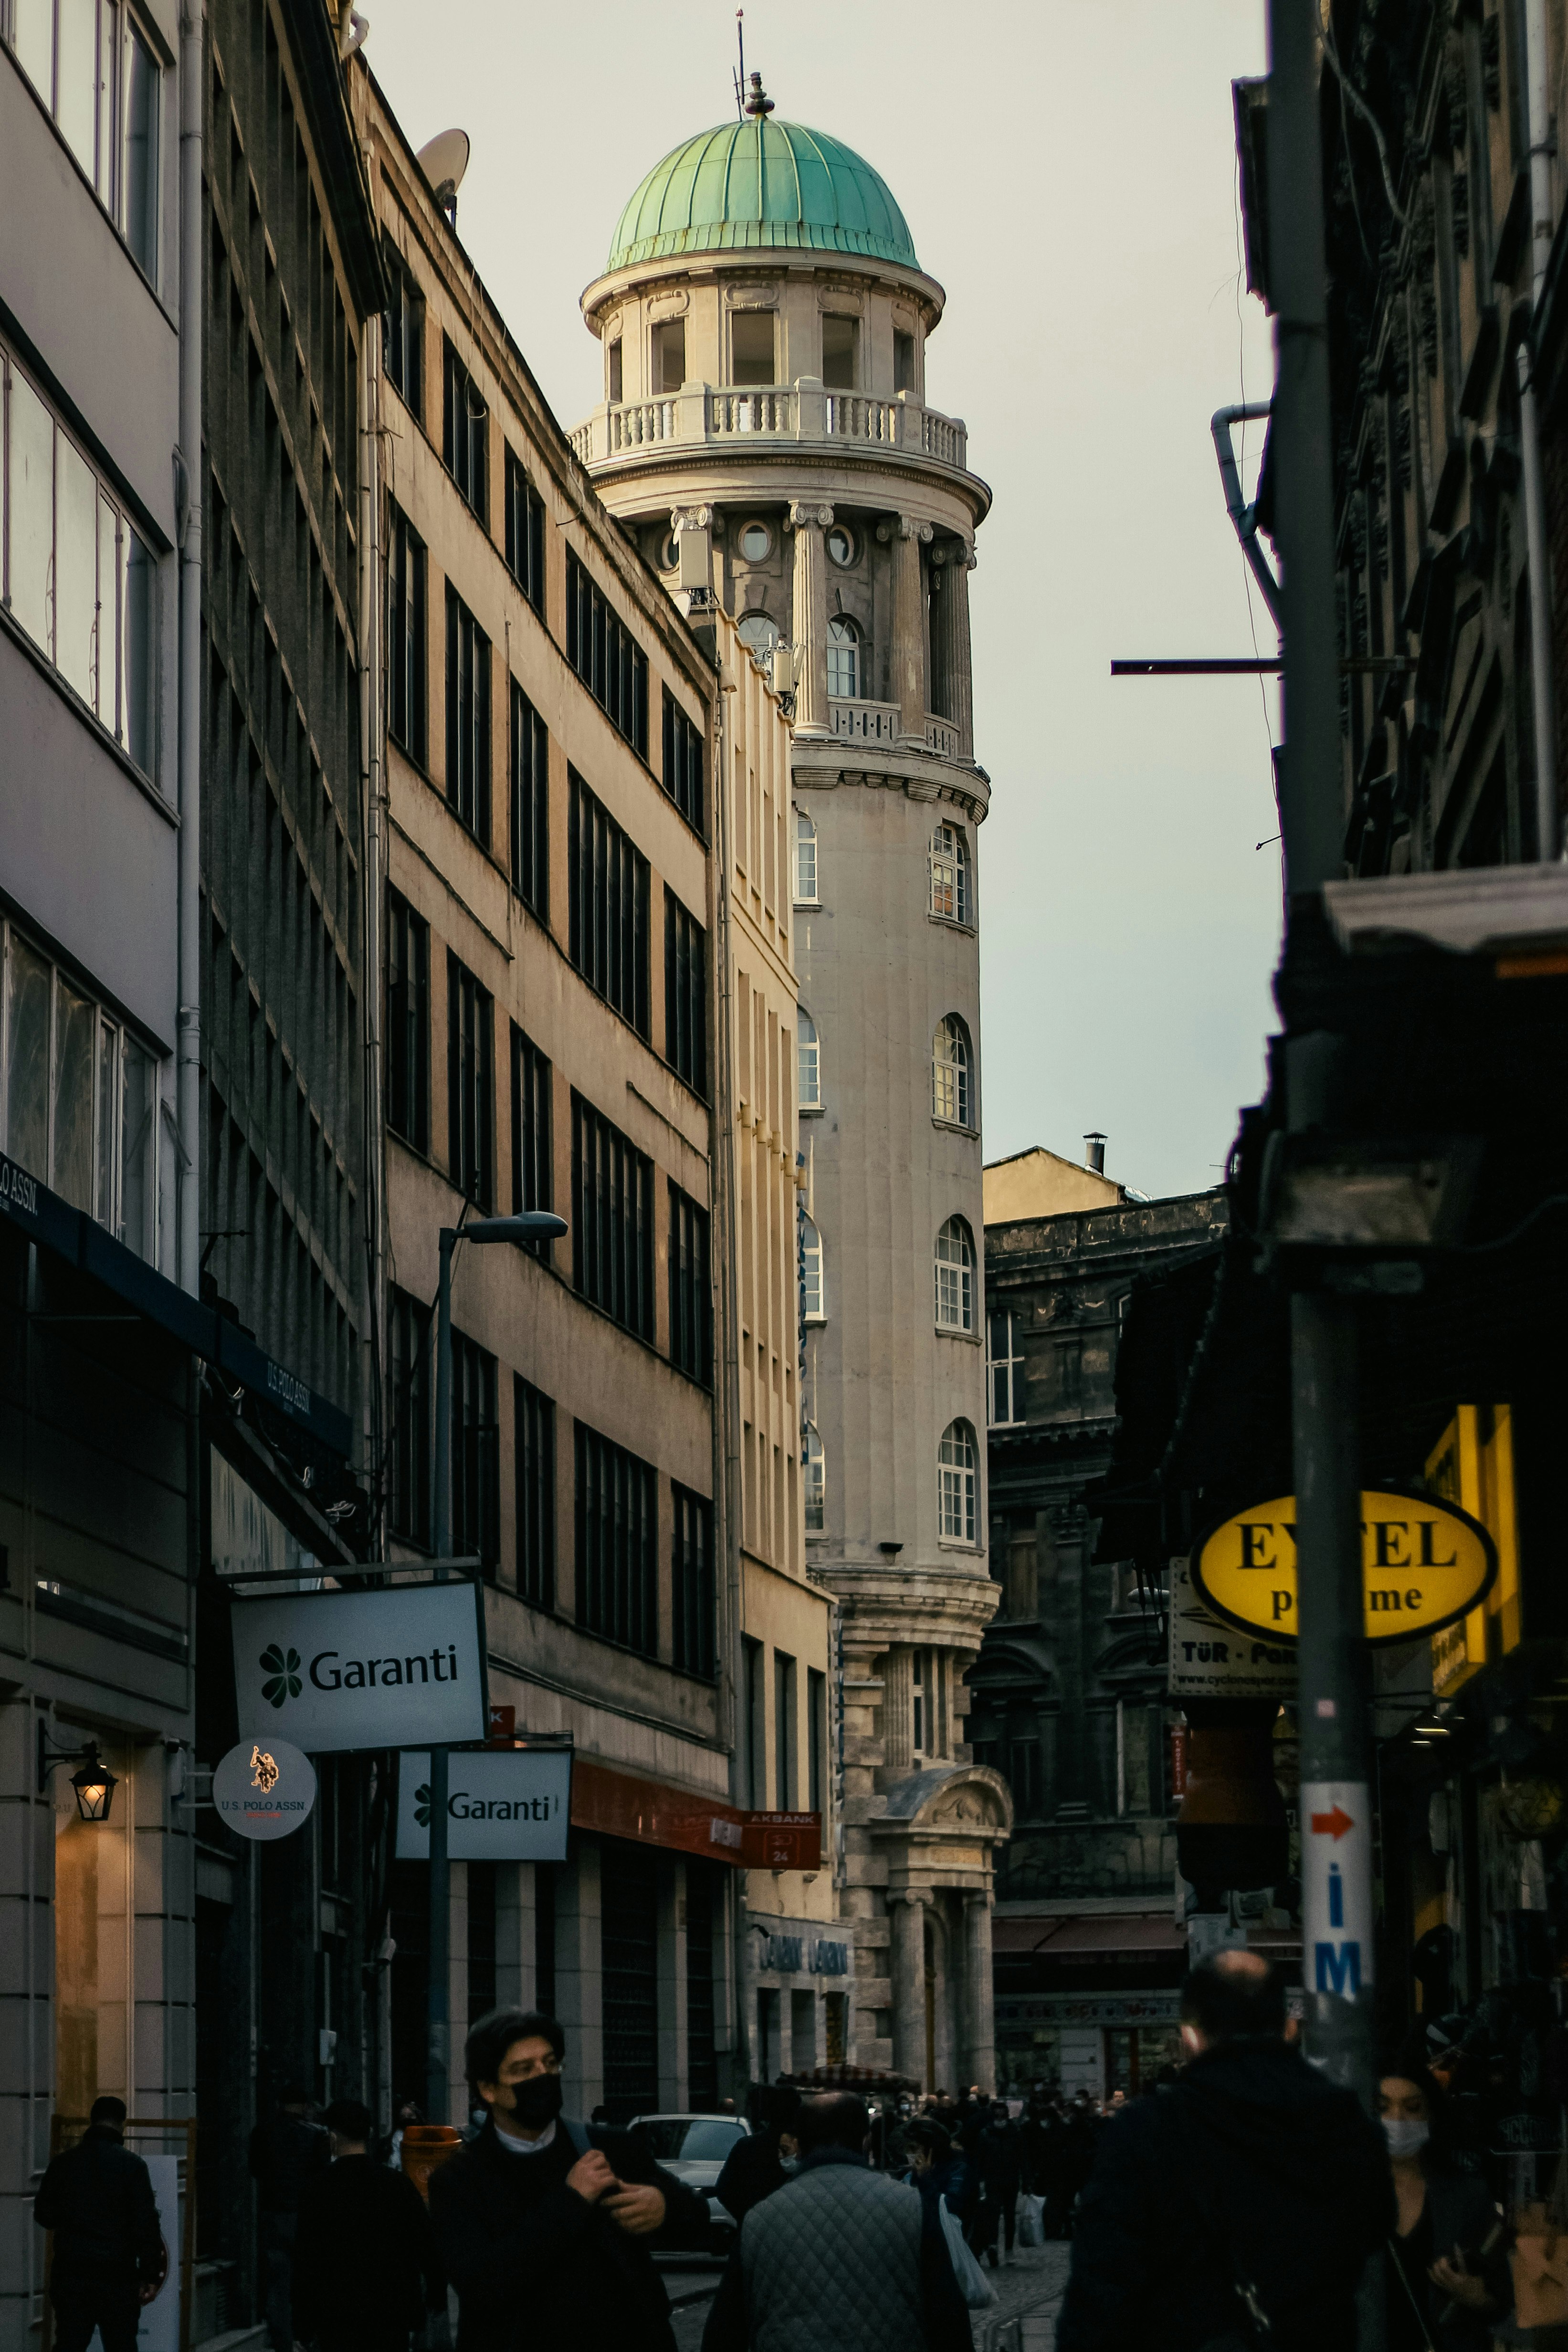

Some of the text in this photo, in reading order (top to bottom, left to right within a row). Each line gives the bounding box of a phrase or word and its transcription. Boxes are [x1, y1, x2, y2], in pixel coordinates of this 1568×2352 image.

[279, 1369, 294, 1402] POLO
[1235, 1520, 1457, 1569] EEL
[309, 1644, 458, 1691] Garanti
[221, 1801, 241, 1810] U.S.
[243, 1801, 273, 1810] POLO
[448, 1792, 549, 1821] Garanti
[751, 1814, 814, 1824] AKBANK
[773, 1850, 789, 1862] 24
